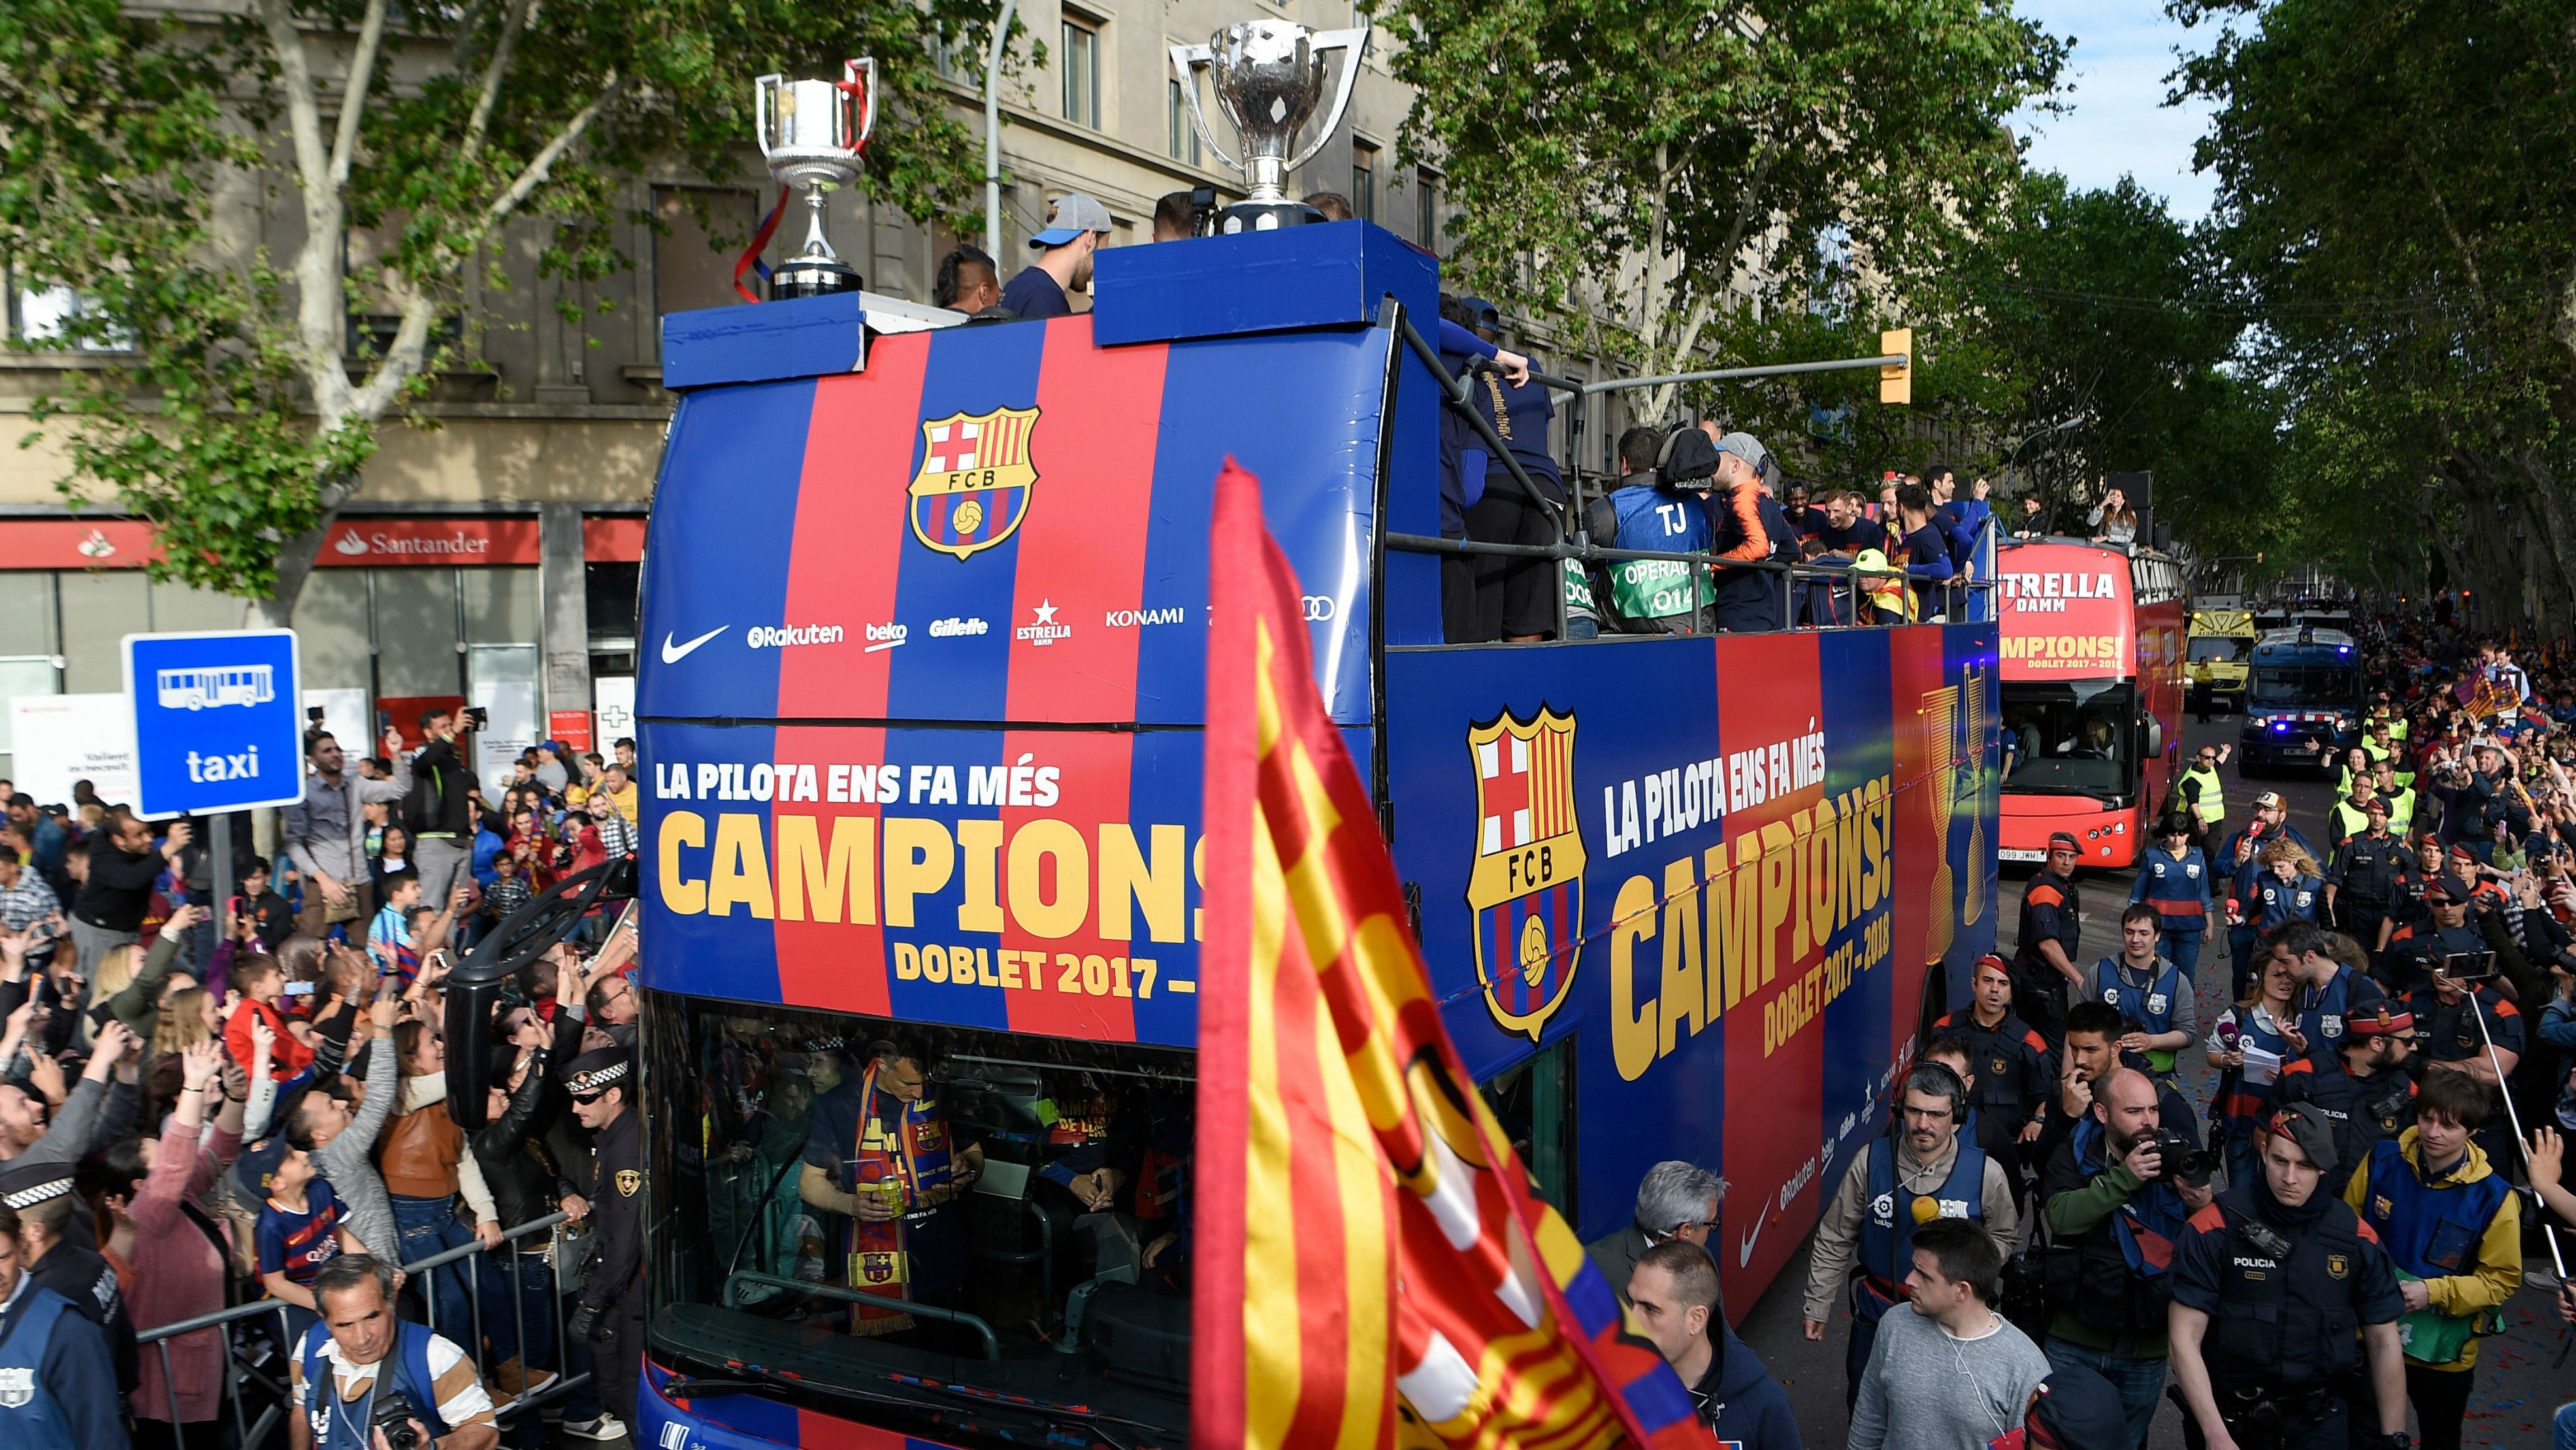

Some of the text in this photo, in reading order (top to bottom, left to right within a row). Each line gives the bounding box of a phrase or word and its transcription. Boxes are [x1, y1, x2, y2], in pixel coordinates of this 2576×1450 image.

[949, 470, 995, 490] FCB
[1655, 502, 1687, 536] TJ
[370, 531, 489, 555] Santander
[1105, 607, 1184, 627] KONAMI
[2015, 598, 2066, 612] DAMM
[866, 621, 908, 641] beko
[928, 617, 989, 638] Gillette
[1016, 625, 1071, 640] ESTRELLA
[2027, 659, 2065, 669] DOBLET
[2066, 659, 2090, 668] 2017
[186, 744, 260, 783] taxi
[656, 751, 1061, 808] LA PILOTA ENS FA MÉS
[1604, 715, 1826, 859] LA PILOTA ENS FA MÉS
[1508, 845, 1553, 894] FCB
[1610, 773, 1892, 1082] CAMPIONS!
[893, 942, 1047, 991] DOBLET
[1055, 952, 1158, 999] 2017
[1764, 962, 1822, 1059] DOBLET
[1824, 938, 1853, 1007] 2017
[1864, 910, 1890, 972] 2018
[2233, 1257, 2277, 1269] POLICIA
